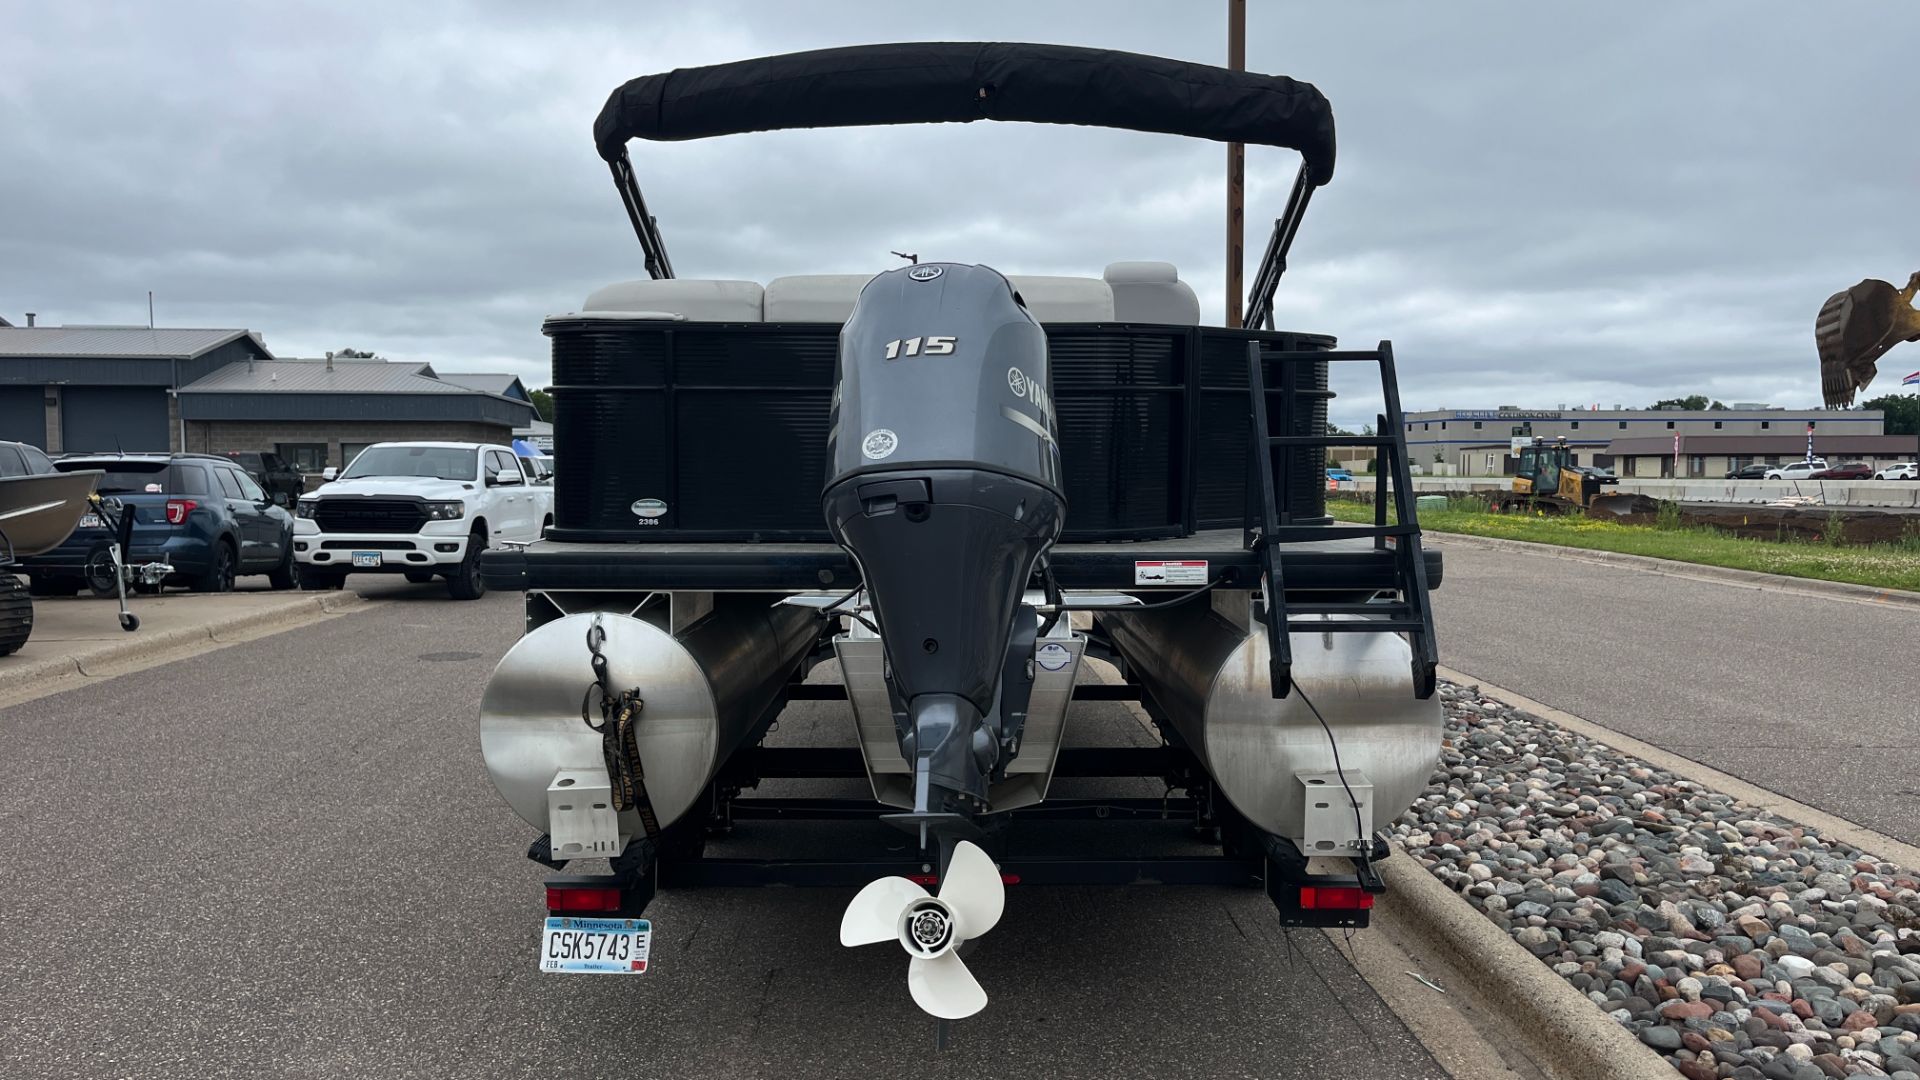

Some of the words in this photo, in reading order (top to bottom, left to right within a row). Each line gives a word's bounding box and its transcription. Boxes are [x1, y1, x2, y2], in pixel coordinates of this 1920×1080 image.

[886, 336, 957, 360] 115
[1026, 376, 1053, 418] YAM
[573, 919, 623, 930] Minnesota
[549, 931, 630, 960] CSK5743
[636, 934, 646, 949] E
[546, 960, 558, 969] FEB
